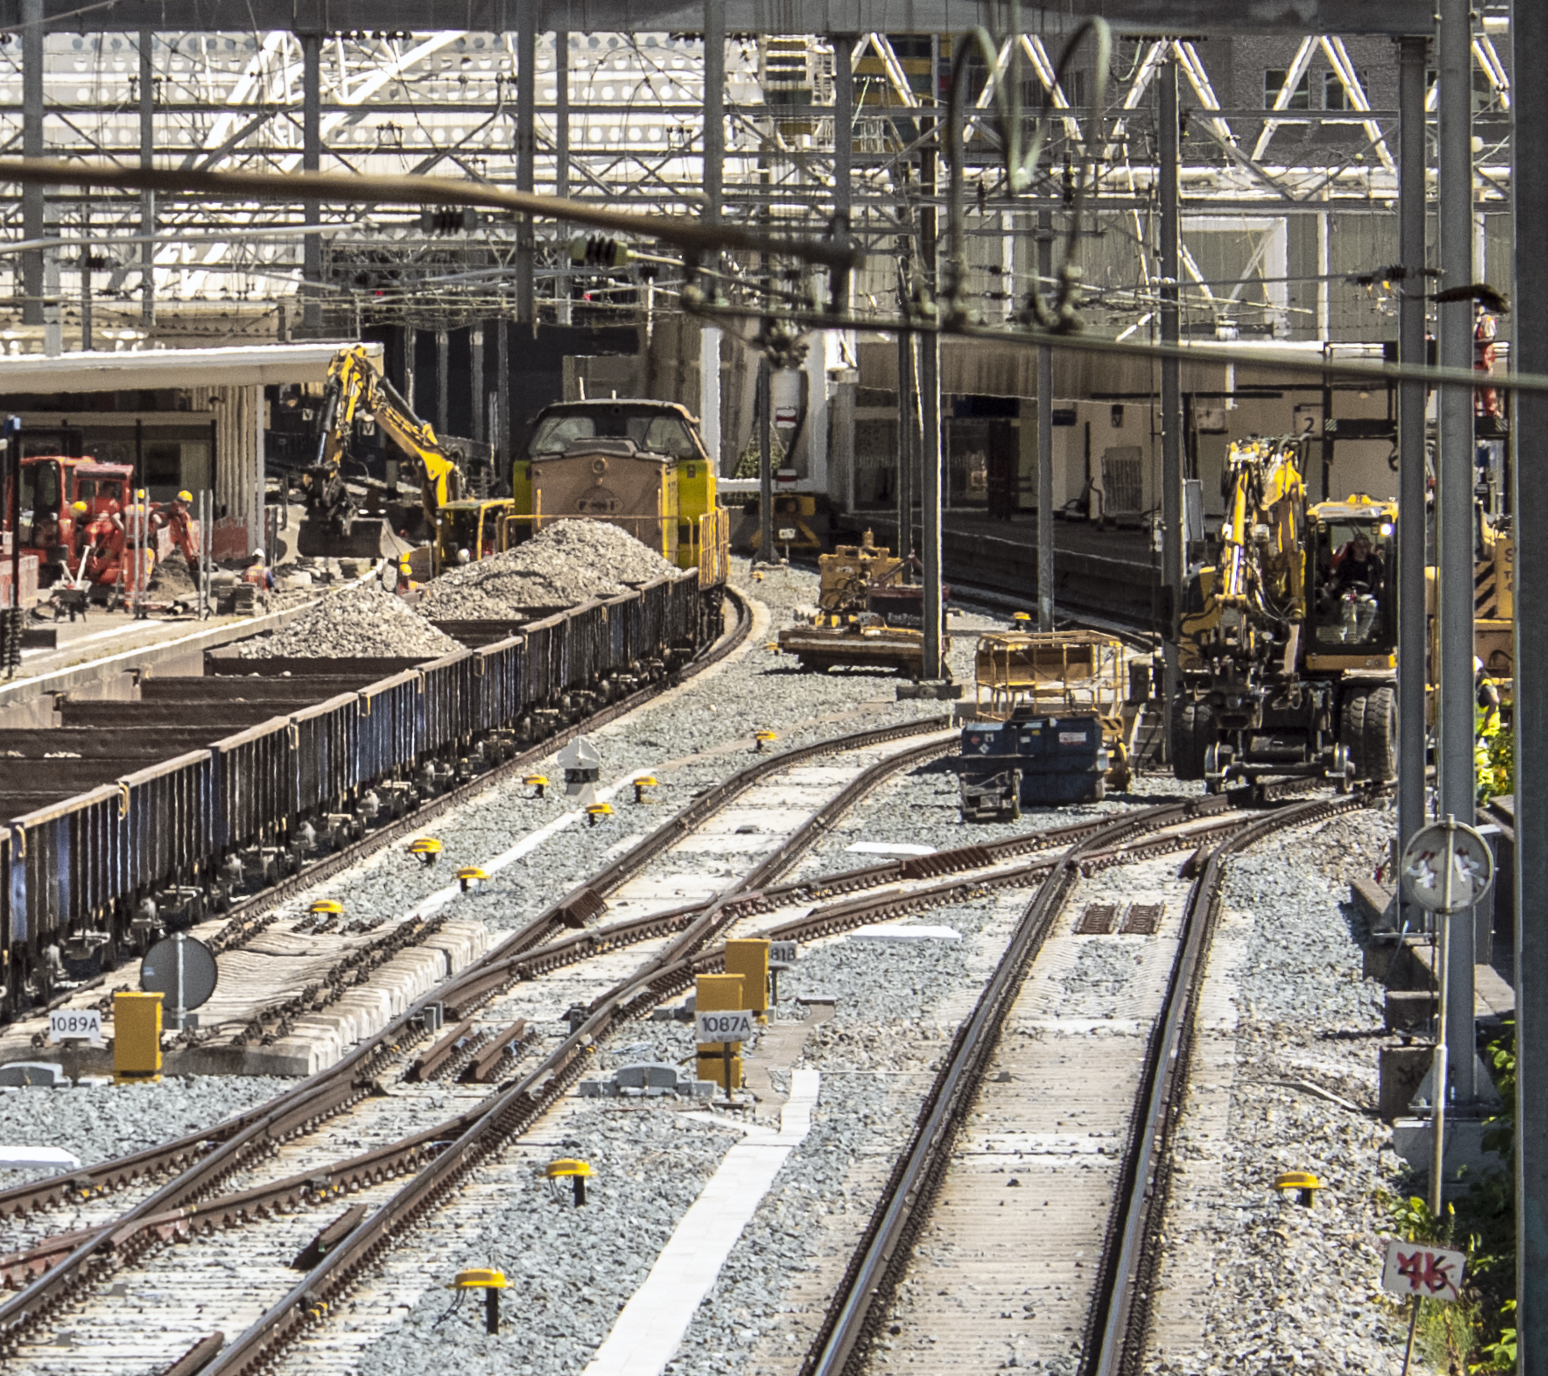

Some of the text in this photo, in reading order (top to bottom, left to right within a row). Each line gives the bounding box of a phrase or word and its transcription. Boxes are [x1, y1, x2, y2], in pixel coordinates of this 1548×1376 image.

[1303, 417, 1315, 433] 2
[51, 1016, 99, 1032] 1089A
[701, 1016, 751, 1033] 1087A
